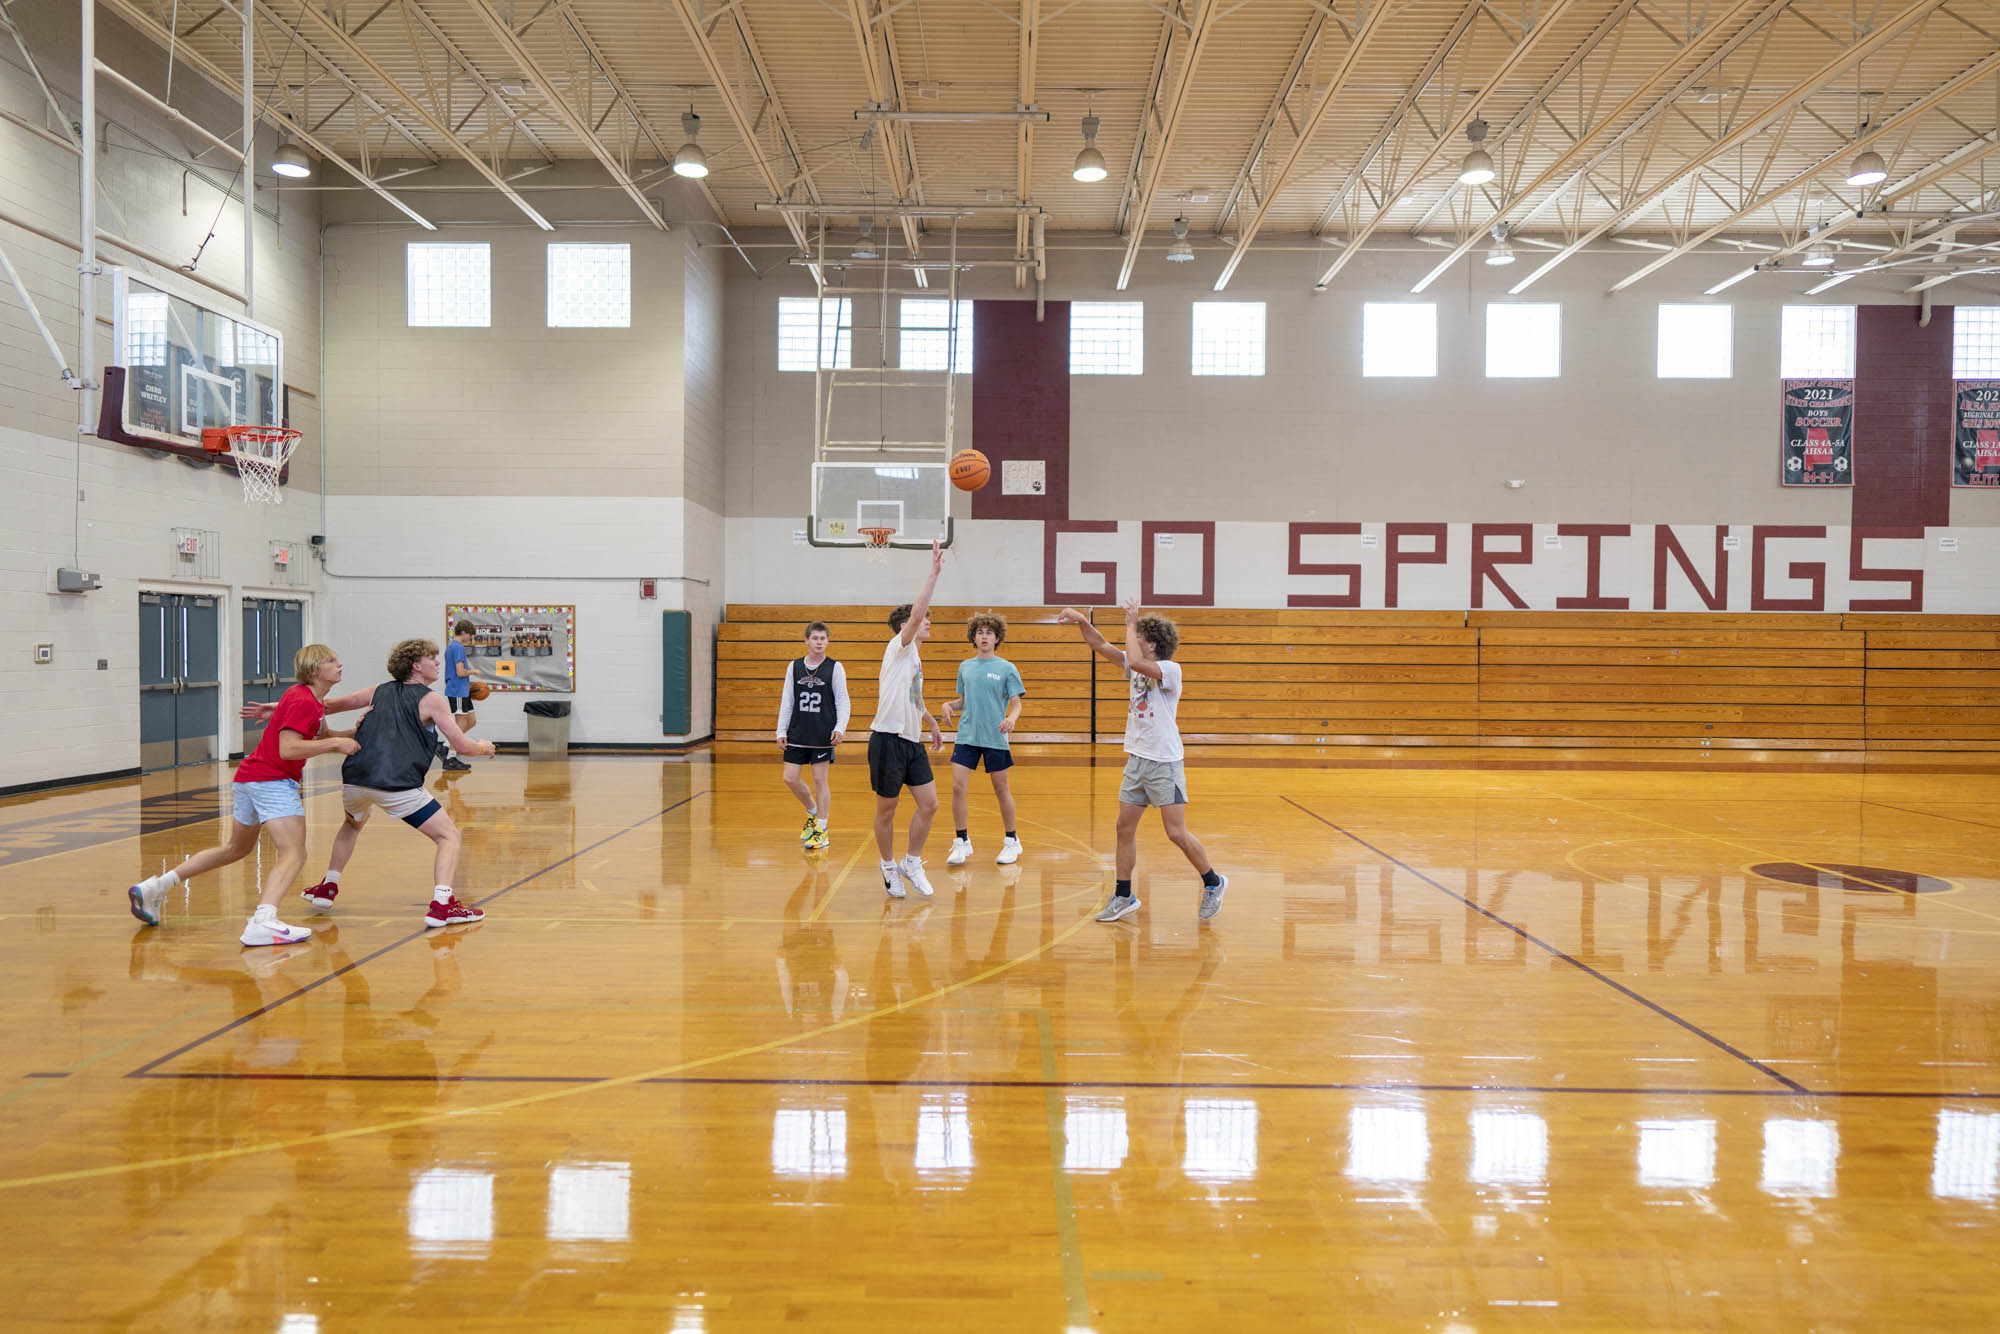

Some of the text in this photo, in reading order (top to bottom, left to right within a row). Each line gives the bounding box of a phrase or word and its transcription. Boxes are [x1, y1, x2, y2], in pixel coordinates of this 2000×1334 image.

[1804, 389, 1834, 400] 2021
[1976, 390, 2000, 401] 202
[1795, 417, 1843, 427] SOCCER
[1790, 439, 1846, 447] CLASS 4A-5A
[1962, 440, 1990, 449] CLASS
[1802, 447, 1834, 455] AHSAA
[1974, 449, 2000, 457] AHSA
[1969, 473, 2000, 485] ELITE
[185, 537, 199, 552] EXIT
[1043, 520, 1925, 612] GO SPRINGS
[800, 691, 822, 713] 22
